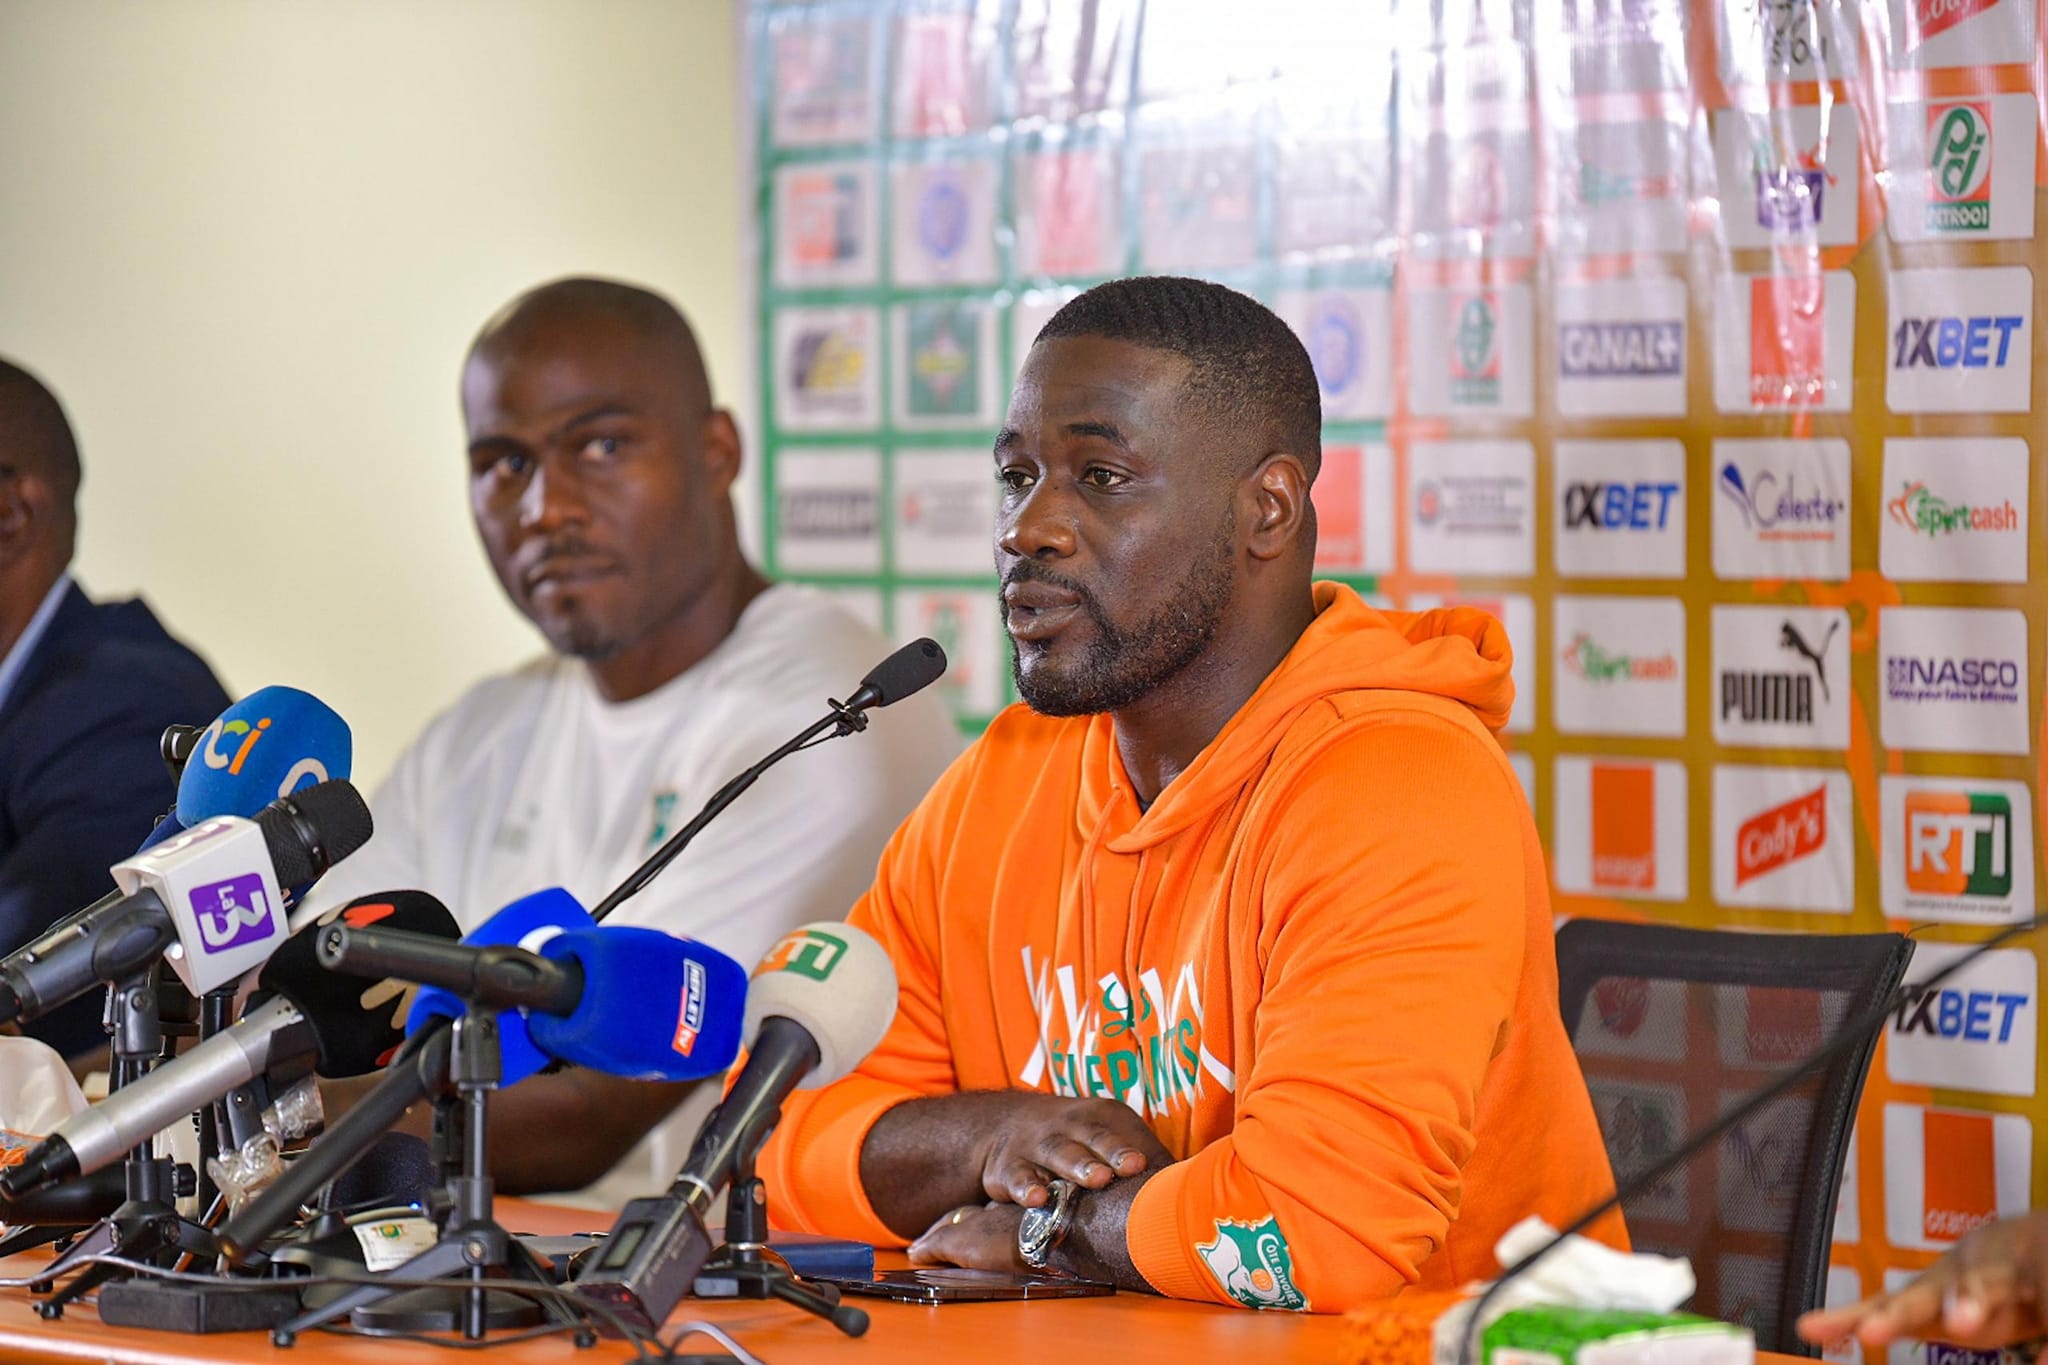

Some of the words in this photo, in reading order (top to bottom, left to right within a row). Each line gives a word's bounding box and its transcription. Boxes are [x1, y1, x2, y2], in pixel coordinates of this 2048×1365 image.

[1564, 326, 1681, 373] CANAL+
[1895, 317, 2023, 369] 1XBET
[1564, 482, 1679, 530] 1XBET
[1917, 498, 2018, 537] sportcash
[1908, 659, 2019, 688] NASCO
[1721, 672, 1813, 724] PUMA
[1910, 811, 2006, 877] RTI
